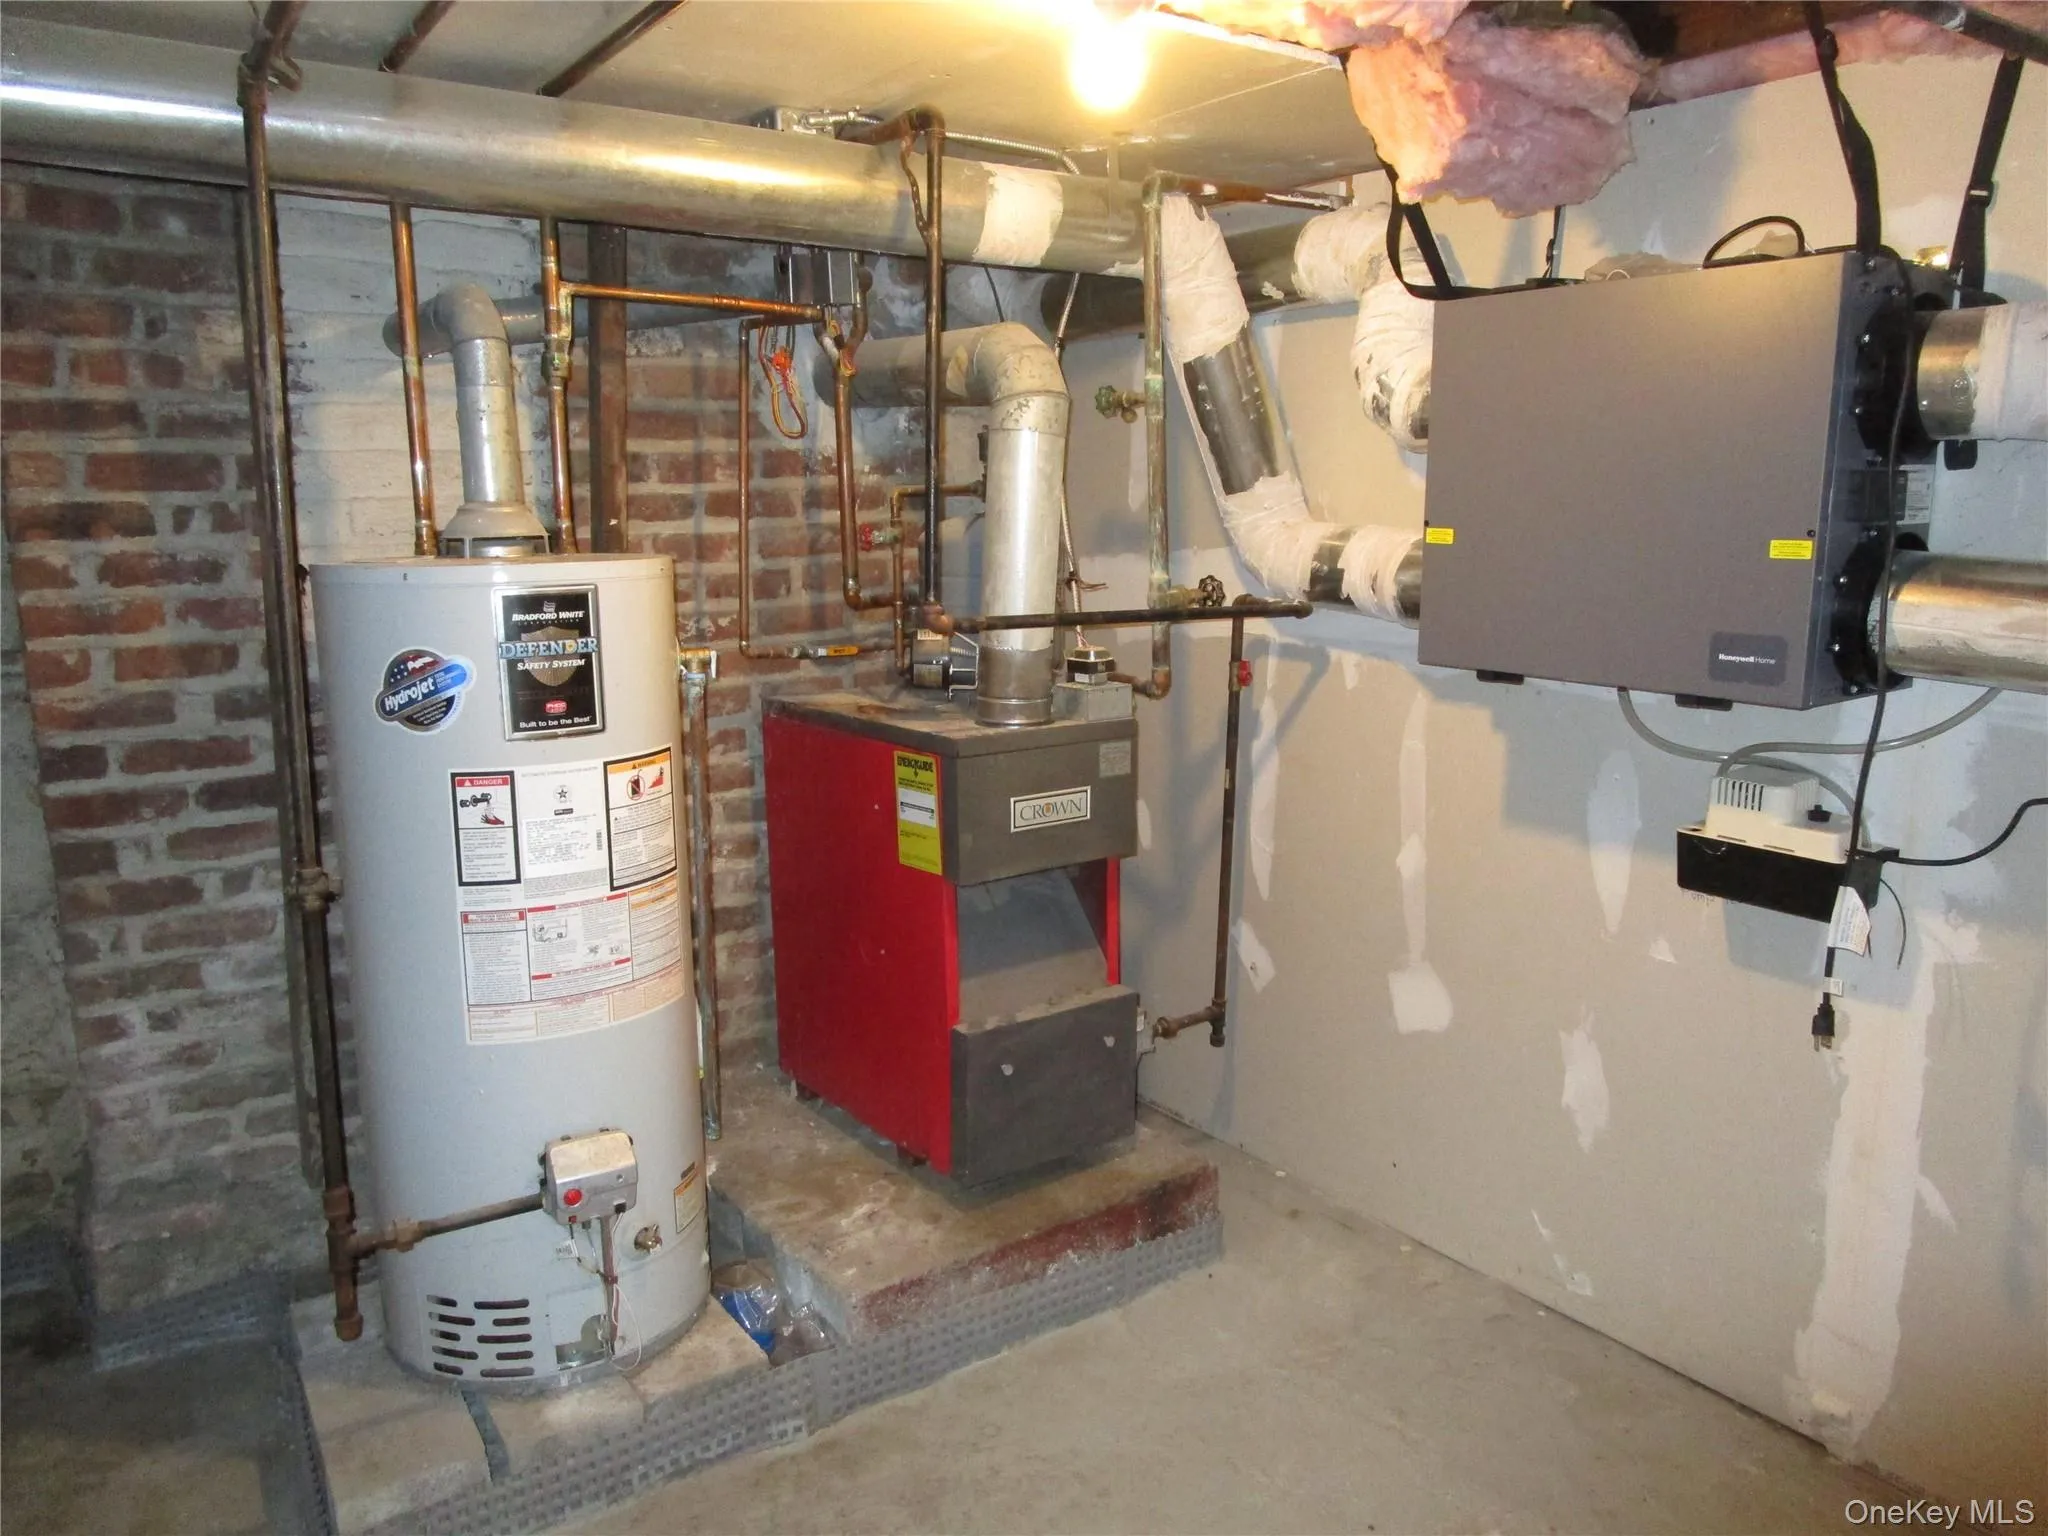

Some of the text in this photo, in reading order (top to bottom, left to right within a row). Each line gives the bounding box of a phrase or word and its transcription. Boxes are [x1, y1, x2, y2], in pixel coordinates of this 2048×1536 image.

[512, 611, 584, 621] BRADFORD WHITE
[500, 638, 598, 658] DEFENDER
[1719, 653, 1776, 664] Honeywell Home
[517, 659, 586, 671] SAFETY SYSTEM
[520, 721, 537, 729] Built
[574, 716, 590, 724] Best
[1019, 797, 1083, 822] CROWN
